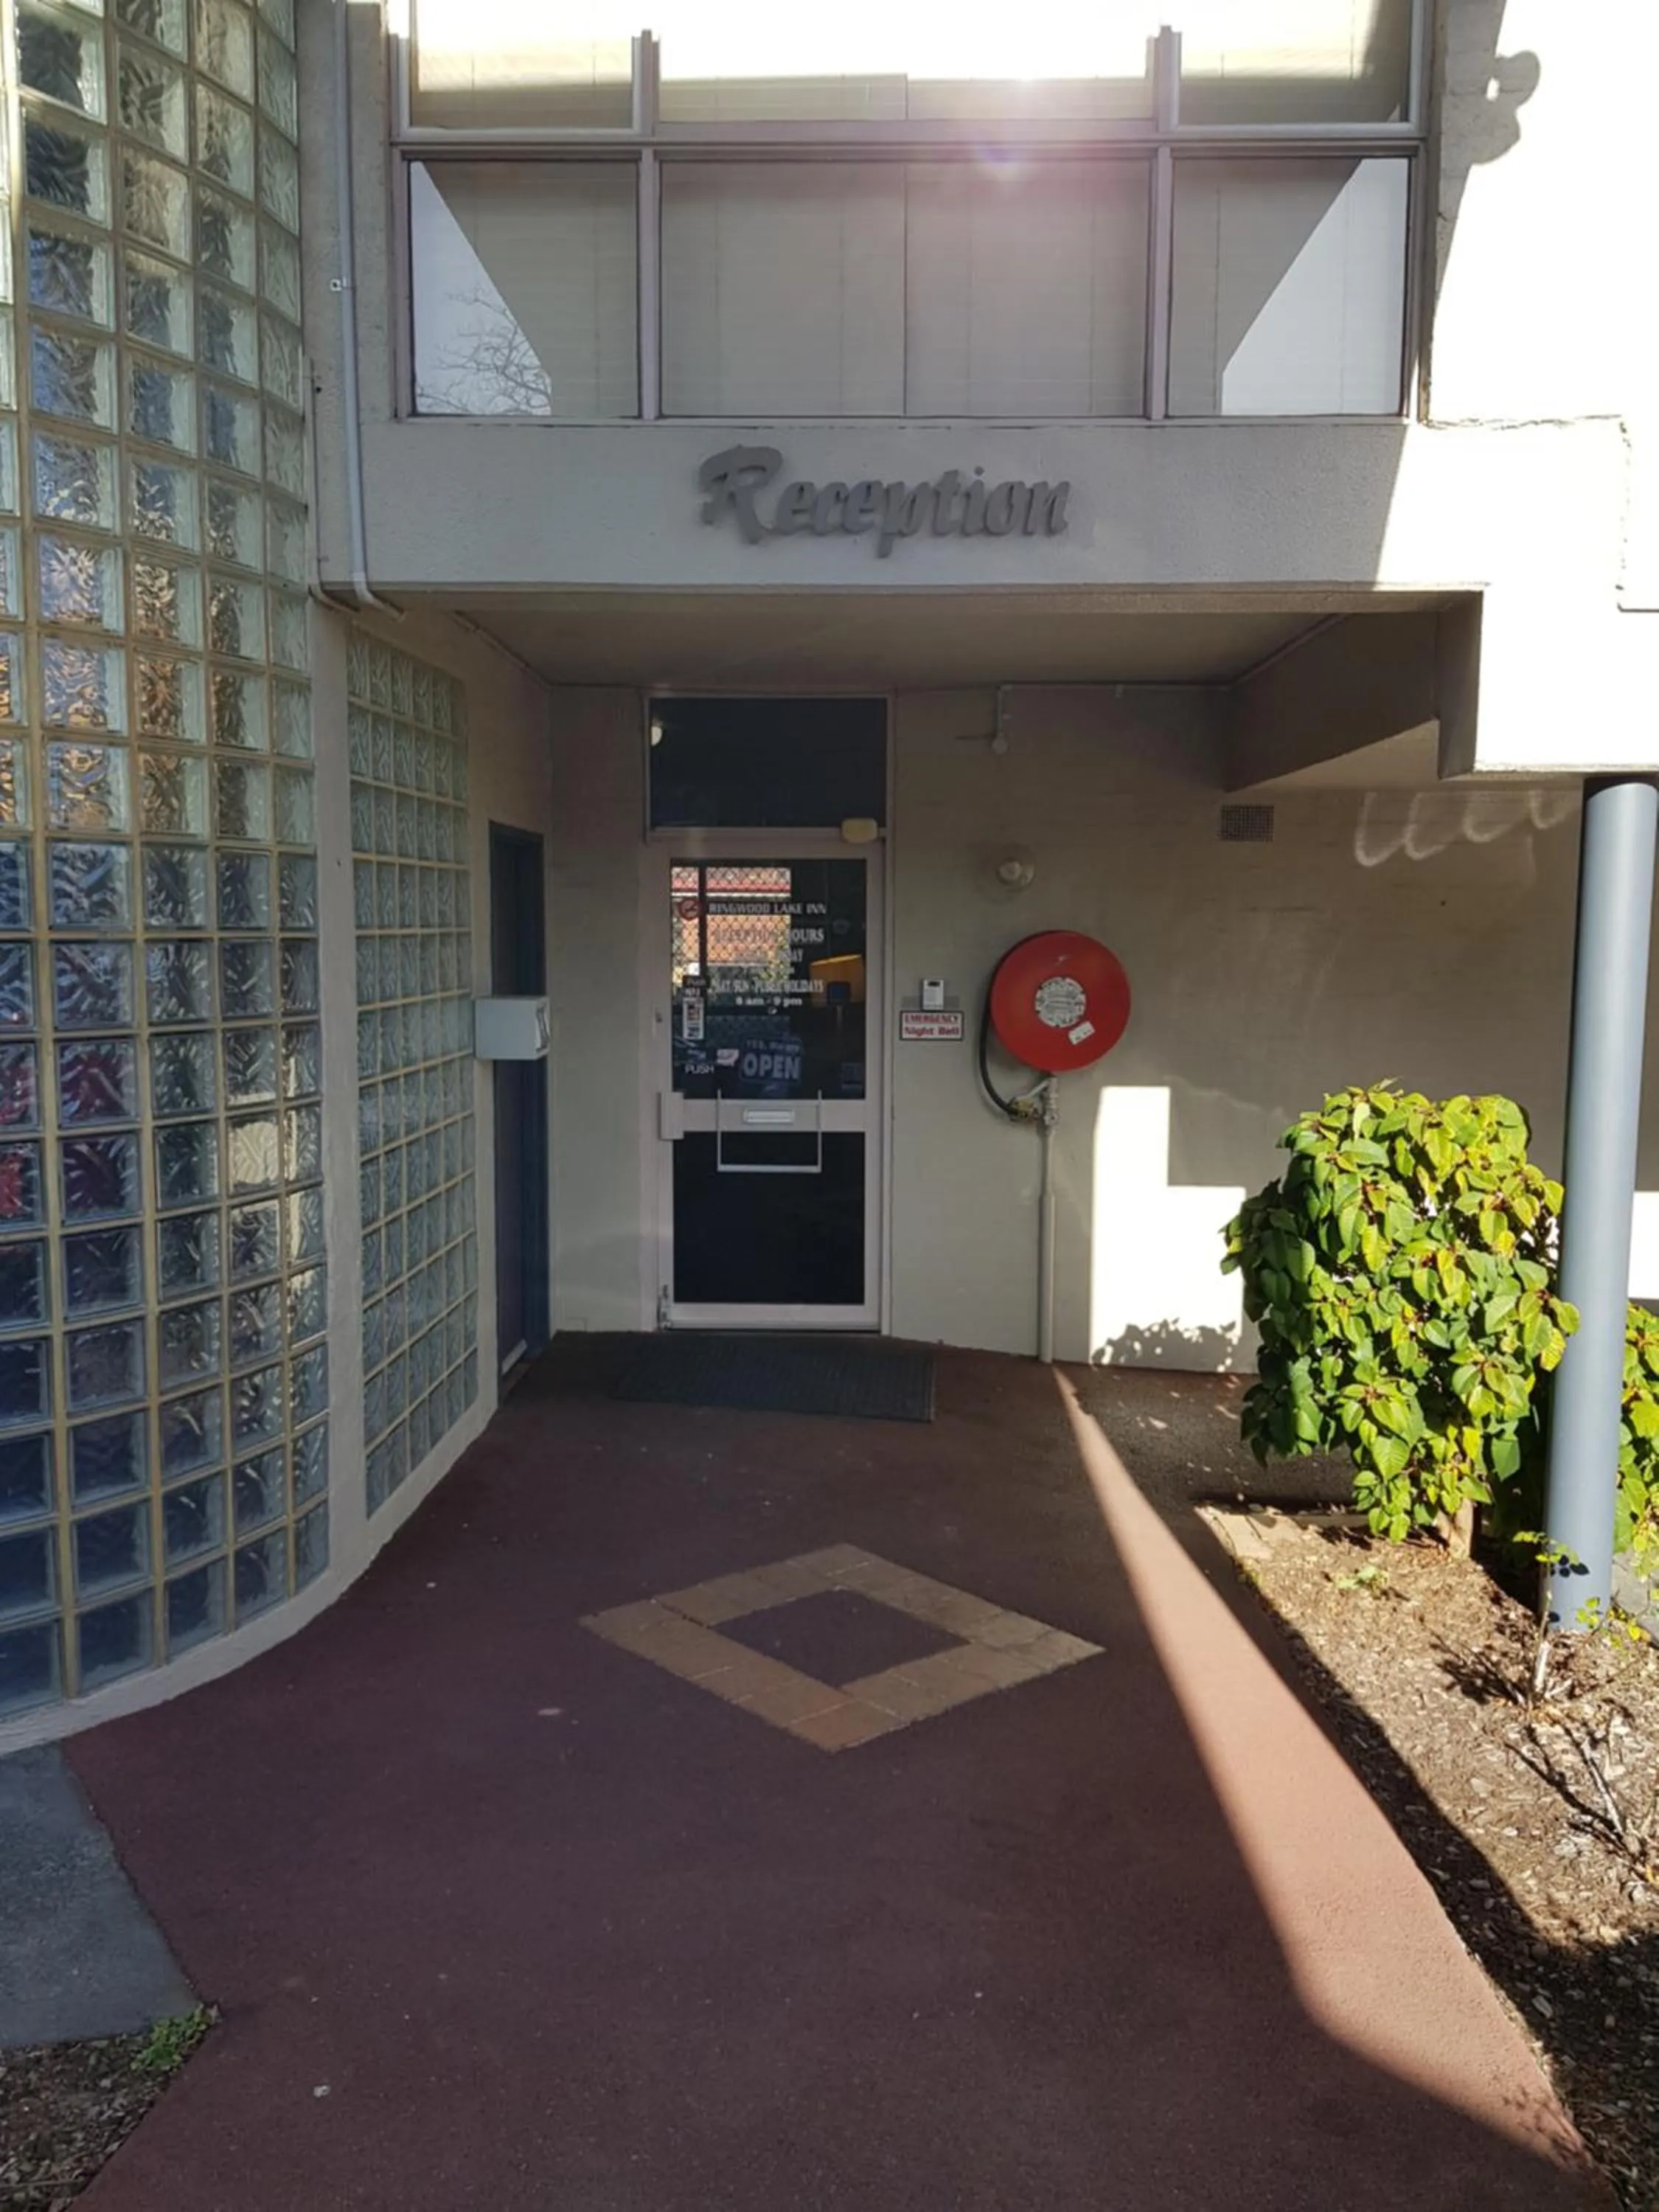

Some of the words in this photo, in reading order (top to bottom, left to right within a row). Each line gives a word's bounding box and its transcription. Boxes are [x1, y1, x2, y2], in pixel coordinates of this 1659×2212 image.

[700, 445, 1071, 558] Reception
[774, 903, 803, 914] LAKE
[807, 903, 827, 914] INN
[905, 1026, 933, 1036] Night
[939, 1026, 959, 1035] Bell
[684, 1065, 714, 1074] PUSH
[743, 1052, 801, 1080] OPEN
